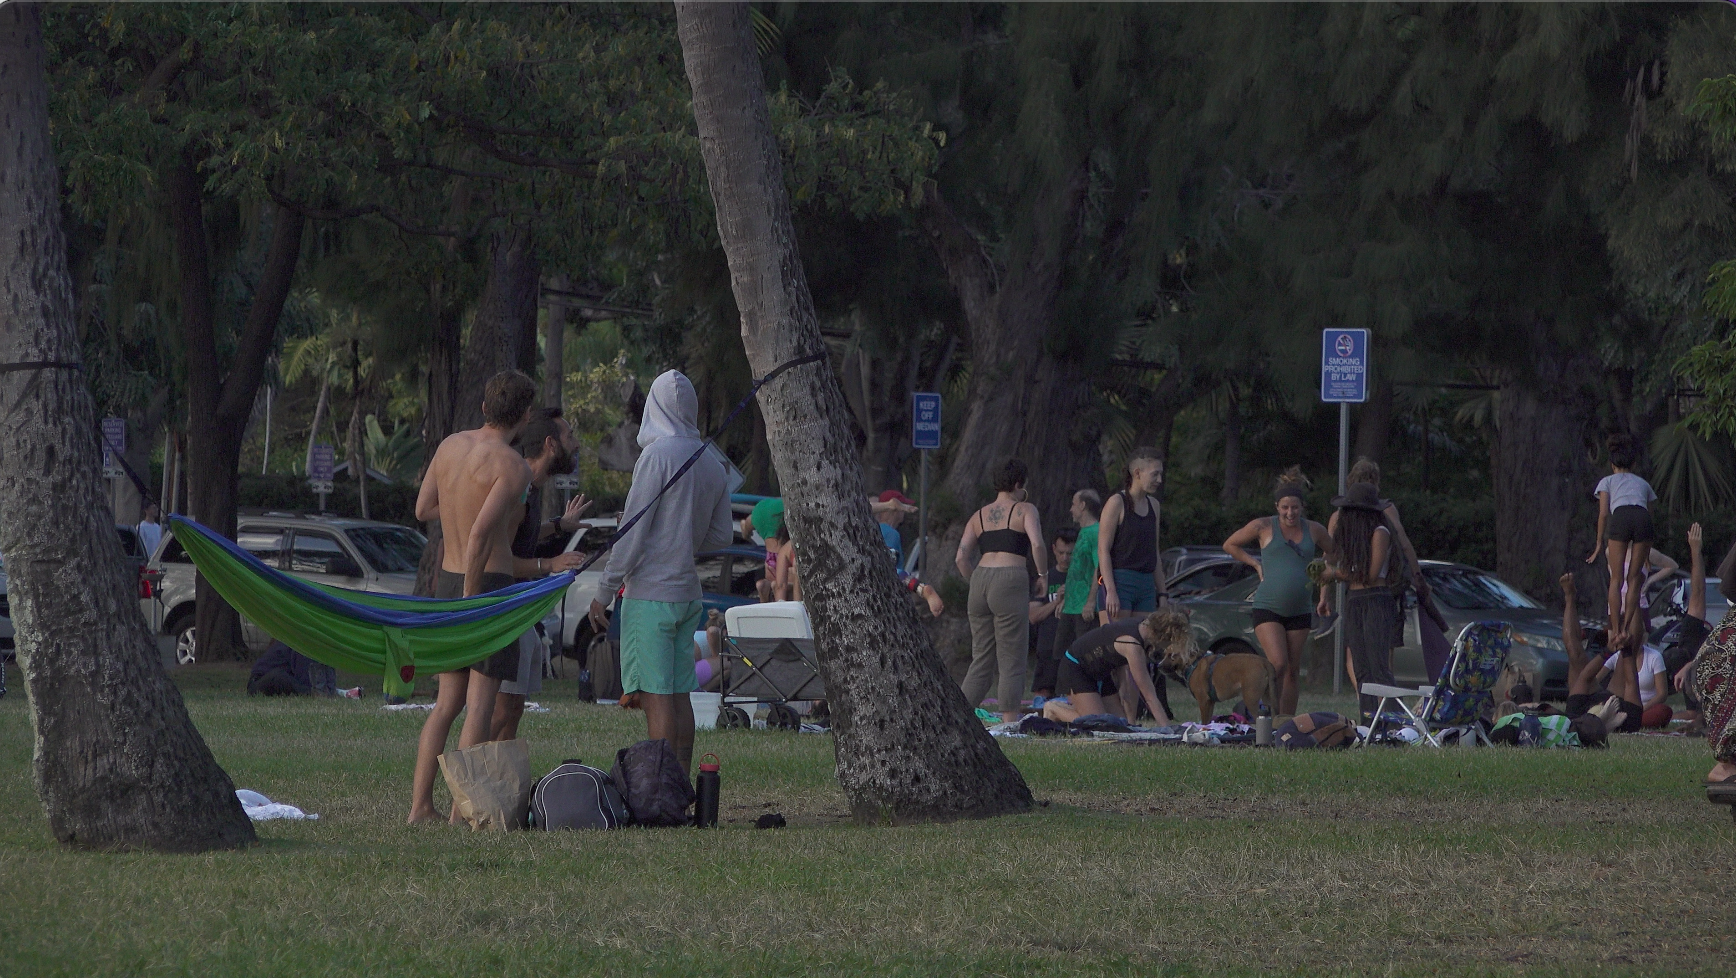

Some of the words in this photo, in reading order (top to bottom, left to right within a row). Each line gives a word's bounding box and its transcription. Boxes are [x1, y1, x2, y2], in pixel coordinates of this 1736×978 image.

[1328, 357, 1360, 365] SMOKING
[1324, 365, 1364, 373] PROHIBITED
[1331, 373, 1340, 381] BY
[1341, 373, 1357, 381] LAW
[919, 401, 936, 410] KEEP
[920, 411, 933, 420] OFF
